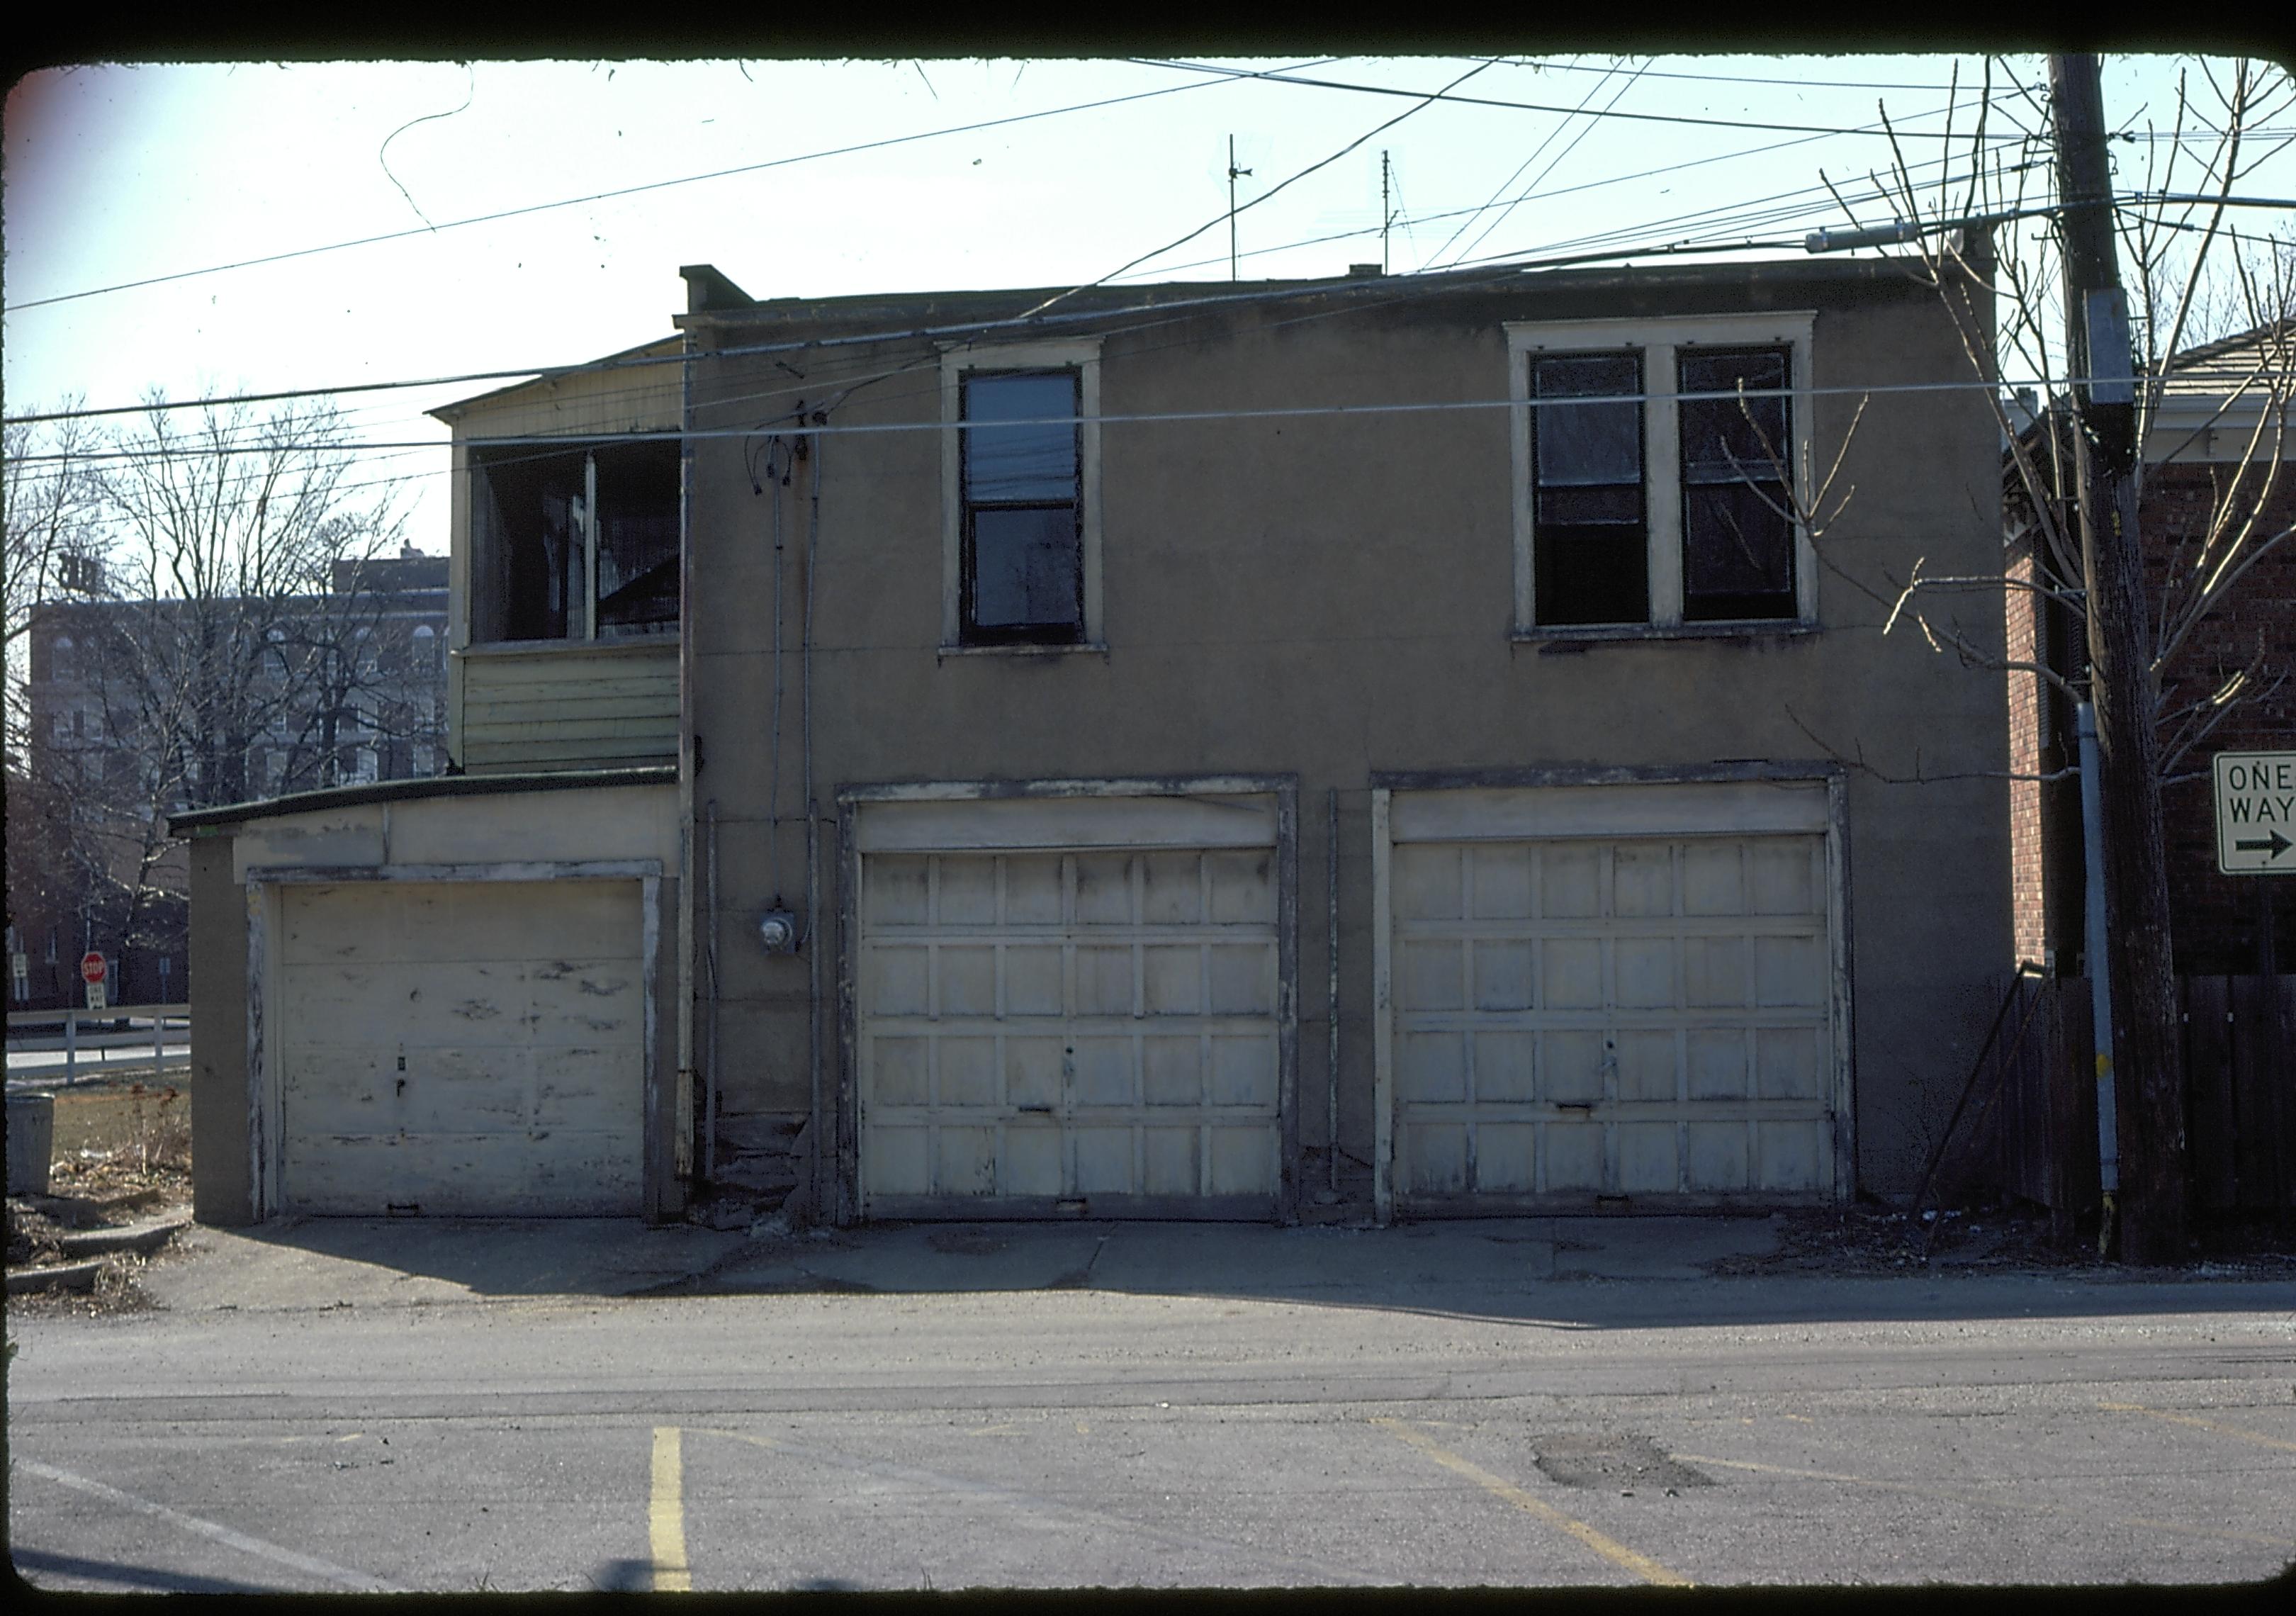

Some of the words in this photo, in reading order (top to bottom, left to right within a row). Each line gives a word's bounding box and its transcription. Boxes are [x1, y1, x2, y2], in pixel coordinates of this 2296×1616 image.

[2229, 765, 2293, 790] ONE
[2229, 796, 2295, 823] WAY
[84, 961, 104, 975] STOP
